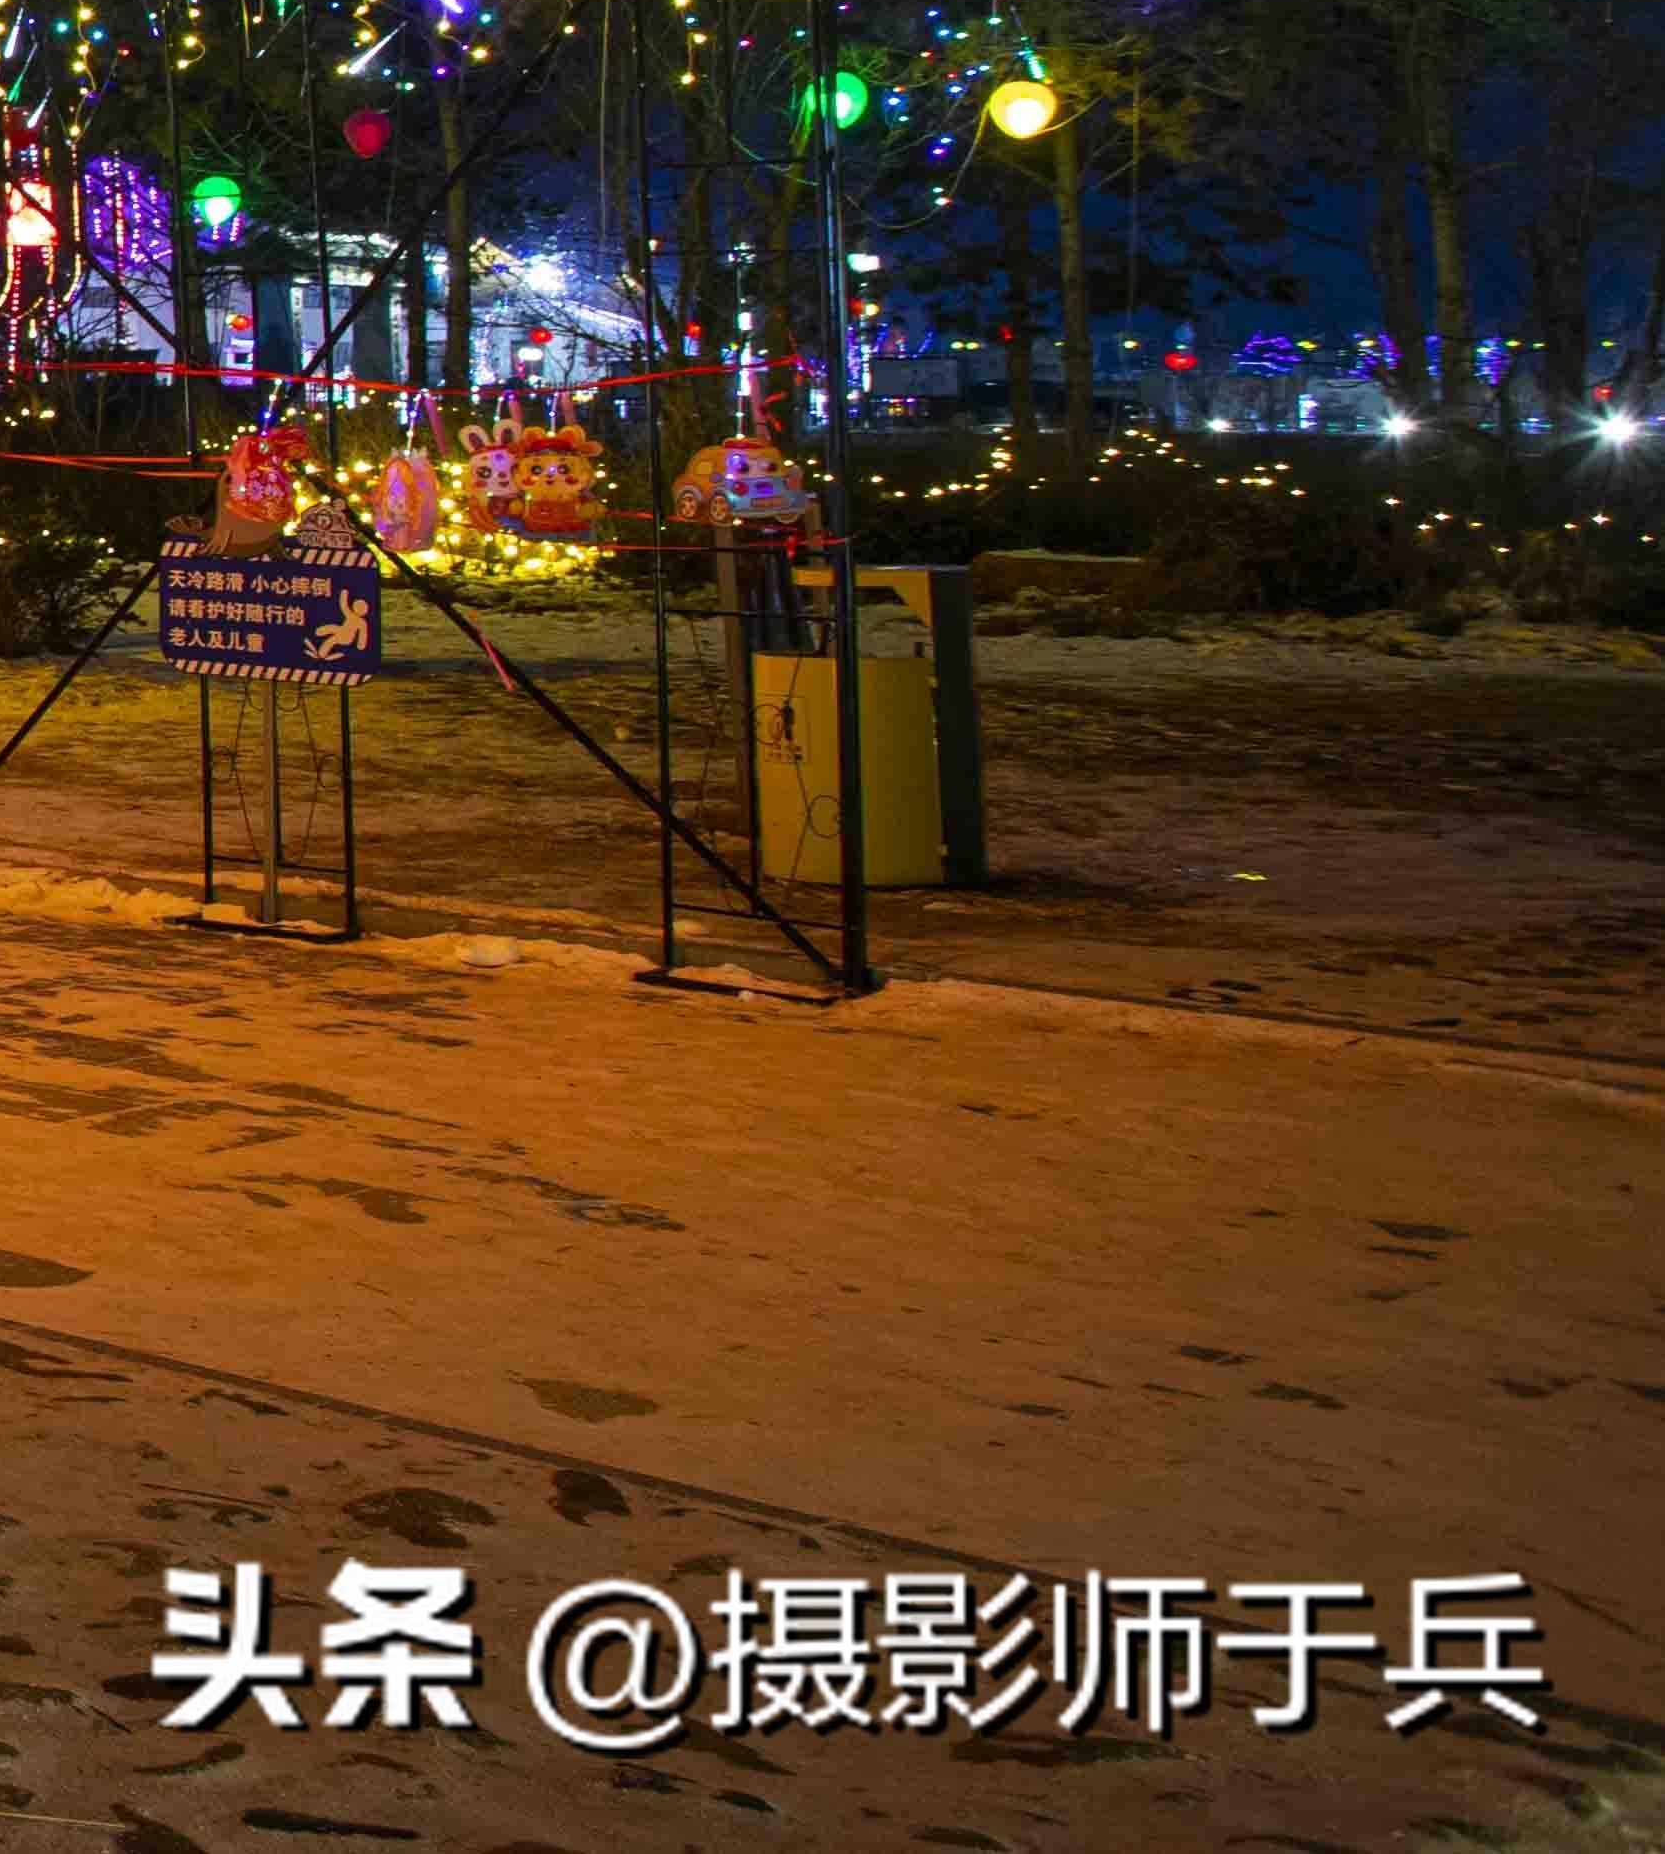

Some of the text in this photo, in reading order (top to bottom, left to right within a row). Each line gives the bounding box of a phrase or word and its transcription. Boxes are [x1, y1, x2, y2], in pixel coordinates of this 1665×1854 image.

[168, 570, 333, 597] 天冷路滑 小心摔倒
[168, 598, 306, 626] 请看护好随行的
[168, 626, 265, 652] 老人及儿童
